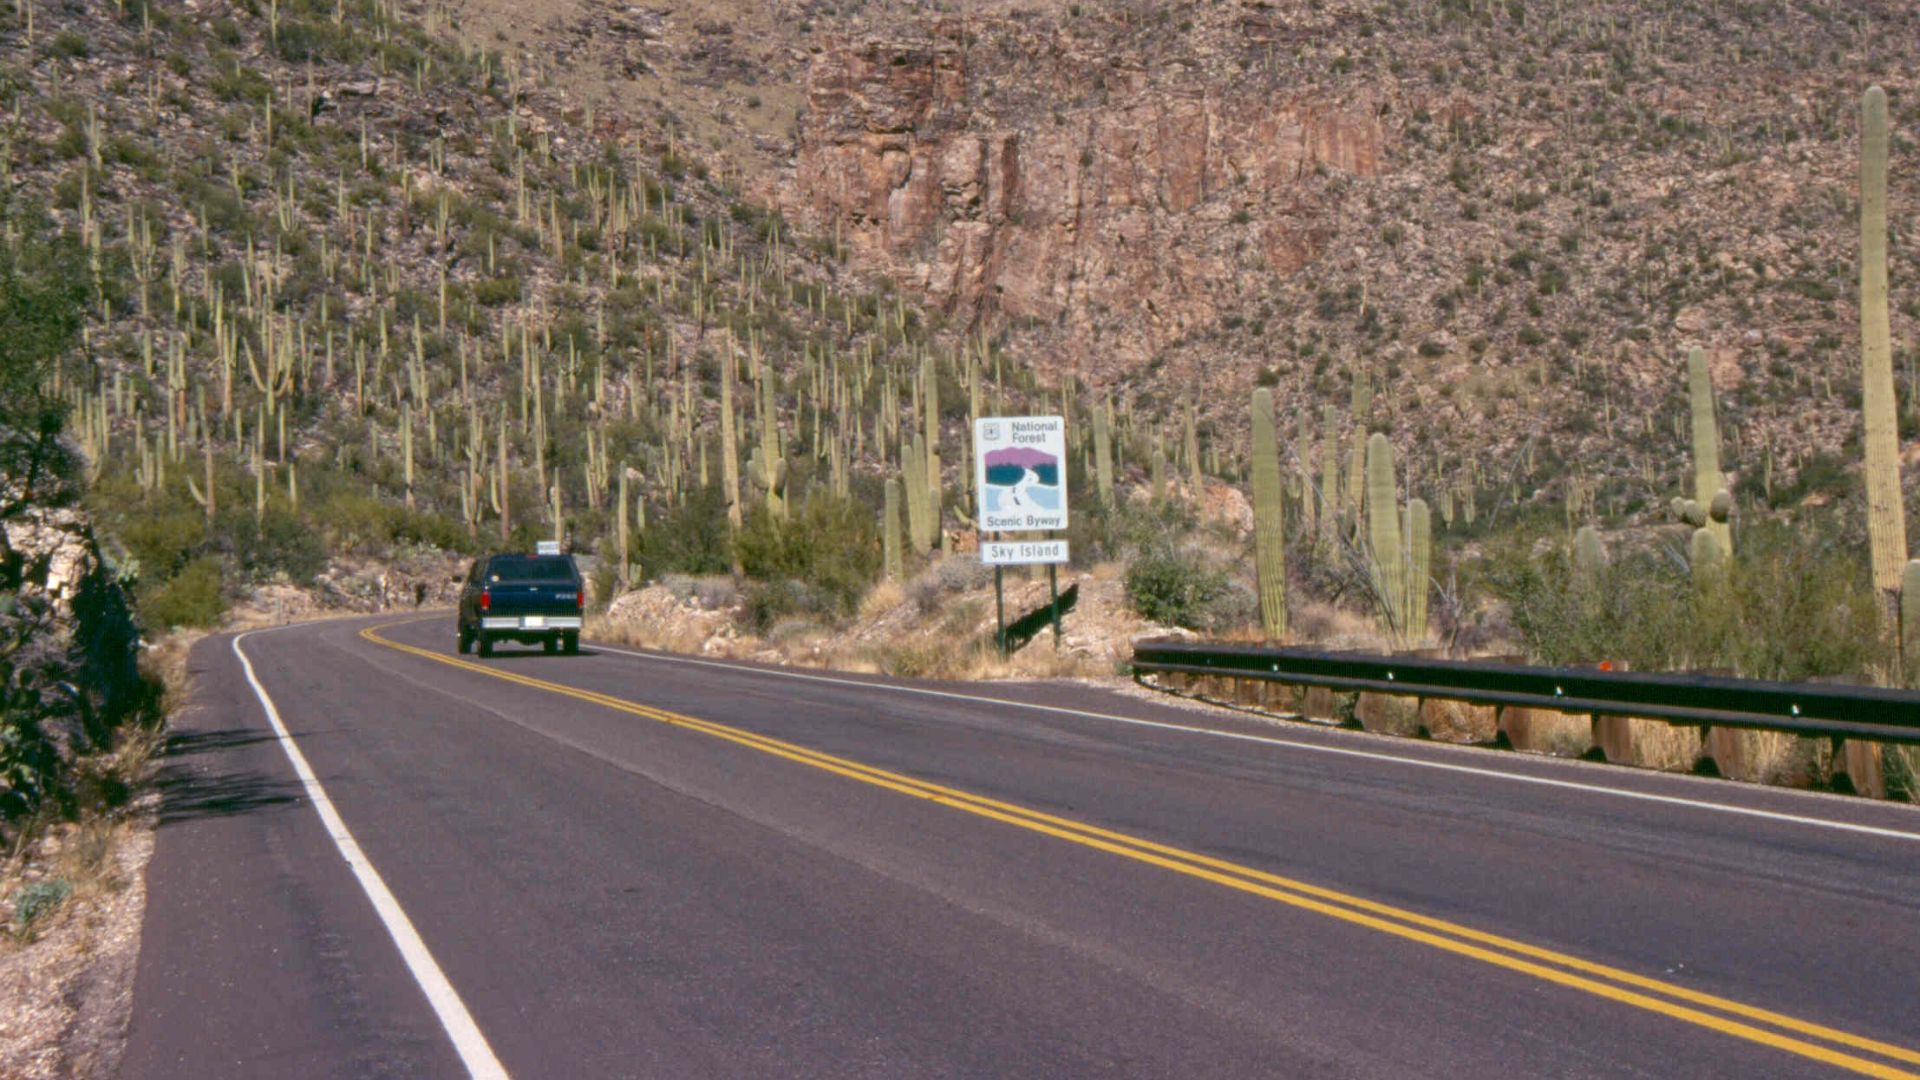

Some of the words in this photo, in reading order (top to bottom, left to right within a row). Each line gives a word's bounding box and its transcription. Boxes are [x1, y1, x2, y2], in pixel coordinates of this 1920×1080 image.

[1011, 421, 1058, 432] National
[1012, 432, 1046, 443] Forest
[986, 516, 1022, 527] Scenic
[1026, 515, 1060, 527] Byway
[991, 545, 1014, 559] Sky
[1020, 544, 1059, 557] Island
